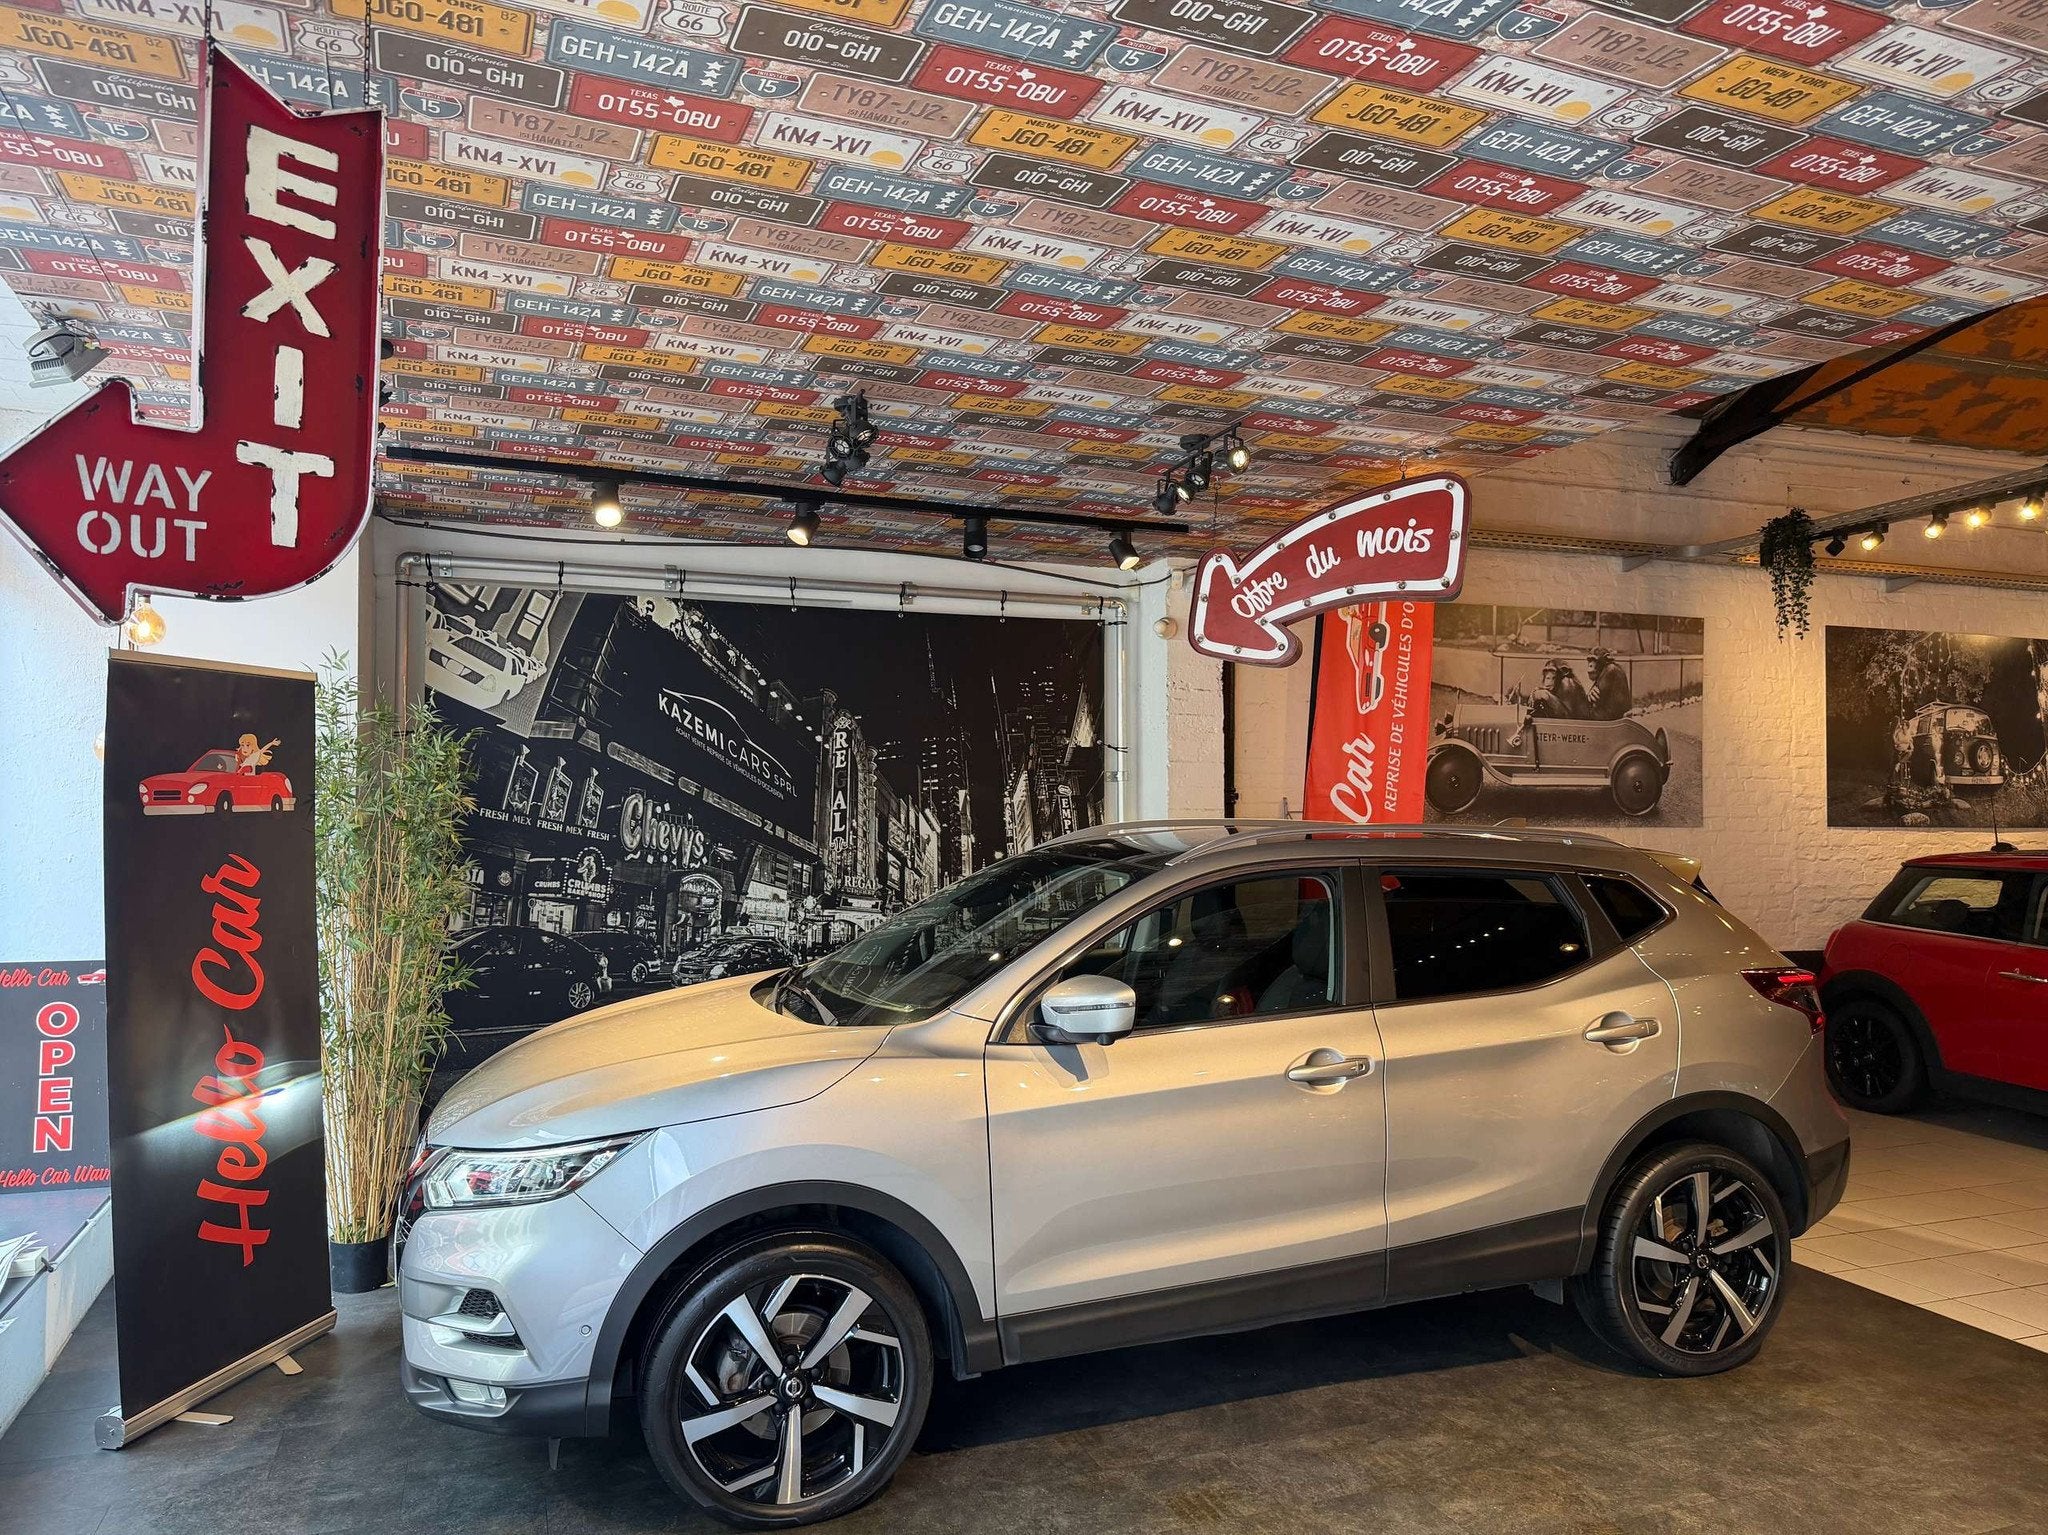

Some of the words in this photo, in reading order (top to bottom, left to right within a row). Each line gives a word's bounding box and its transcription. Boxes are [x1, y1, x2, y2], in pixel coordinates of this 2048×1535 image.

[18, 12, 62, 27] NEW
[74, 23, 128, 39] YORK
[677, 13, 705, 31] 66
[931, 1, 1065, 49] GEH-142A
[1509, 16, 1541, 35] 15
[1366, 30, 1394, 43] TEXAS
[559, 34, 692, 78] GEH-142A
[983, 59, 1014, 72] TEXAS
[1119, 48, 1141, 67] 15
[756, 77, 780, 94] 15
[1760, 65, 1786, 79] NEW
[1797, 73, 1830, 88] YORK
[630, 88, 659, 99] TEXAS
[1987, 82, 2014, 97] 66
[421, 98, 440, 114] 15
[1379, 92, 1409, 105] NEW
[1415, 100, 1452, 114] YORK
[1024, 118, 1060, 130] NEW
[1064, 126, 1105, 139] YORK
[1611, 110, 1636, 125] 66
[1836, 102, 1945, 140] GEH-142A
[105, 122, 129, 137] 15
[695, 143, 730, 154] NEW
[737, 150, 777, 162] YORK
[1259, 135, 1283, 151] 66
[1476, 128, 1585, 163] GEH-142A
[1839, 148, 1862, 158] TEXAS
[1963, 138, 1986, 153] 15
[931, 158, 956, 171] 66
[1140, 153, 1248, 185] GEH-142A
[1495, 171, 1522, 180] TEXAS
[1615, 163, 1633, 176] 15
[826, 174, 934, 204] GEH-142A
[1173, 193, 1199, 201] TEXAS
[63, 212, 88, 222] 66
[531, 191, 638, 220] GEH-142A
[1880, 220, 1958, 250] GEH-142A
[1573, 239, 1664, 264] GEH-142A
[1285, 257, 1376, 281] GEH-142A
[1013, 272, 1104, 295] GEH-142A
[757, 285, 847, 306] GEH-142A
[237, 124, 340, 548] EXIT
[75, 454, 212, 512] WAY
[77, 510, 207, 562] OUT
[1230, 569, 1288, 619] Offre
[1306, 544, 1341, 579] du
[1356, 518, 1434, 558] mois
[1391, 634, 1413, 719] VÉHICULES
[1390, 721, 1404, 746] DE
[658, 693, 724, 750] KAZEMI
[727, 739, 771, 779] CARS
[774, 774, 798, 798] SPRL
[832, 731, 849, 833] REGAL
[1329, 732, 1376, 824] Car
[1384, 746, 1401, 813] REPRISE
[479, 807, 509, 822] FRESH
[512, 814, 532, 826] MEX
[536, 819, 563, 833] FRESH
[565, 825, 583, 836] MEX
[587, 829, 610, 841] FRESH
[620, 793, 705, 868] Chevys
[567, 878, 607, 894] CRUMBS
[191, 853, 265, 1010] Car
[38, 968, 71, 987] Car
[33, 1001, 80, 1153] OPEN
[197, 1023, 271, 1267] Hello
[41, 1167, 71, 1185] Car
